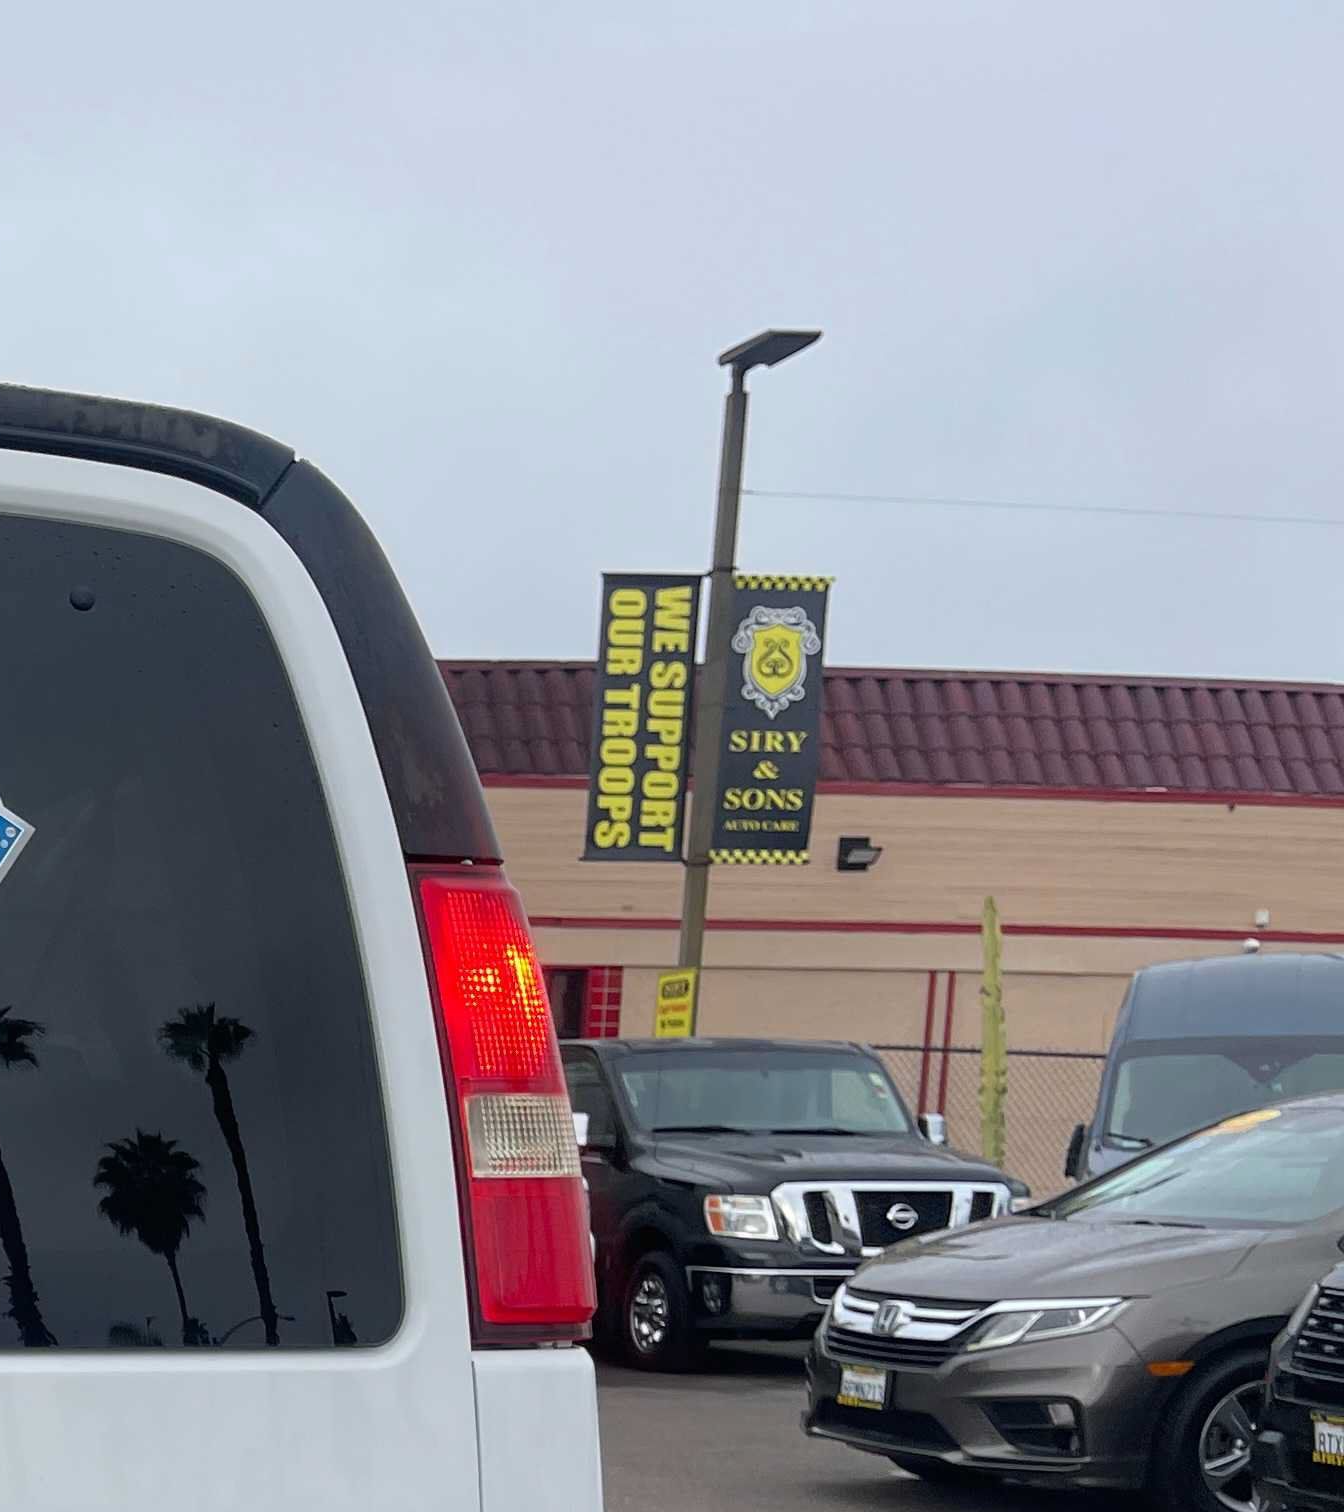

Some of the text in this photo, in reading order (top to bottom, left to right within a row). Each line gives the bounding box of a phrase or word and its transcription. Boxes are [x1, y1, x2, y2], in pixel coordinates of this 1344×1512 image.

[593, 587, 647, 849] OUR TROOPS
[638, 585, 693, 853] WE SUPPORT
[728, 729, 809, 754] SIRY
[752, 760, 781, 780] &
[722, 788, 805, 812] SONS
[723, 819, 800, 833] AUTO CARE
